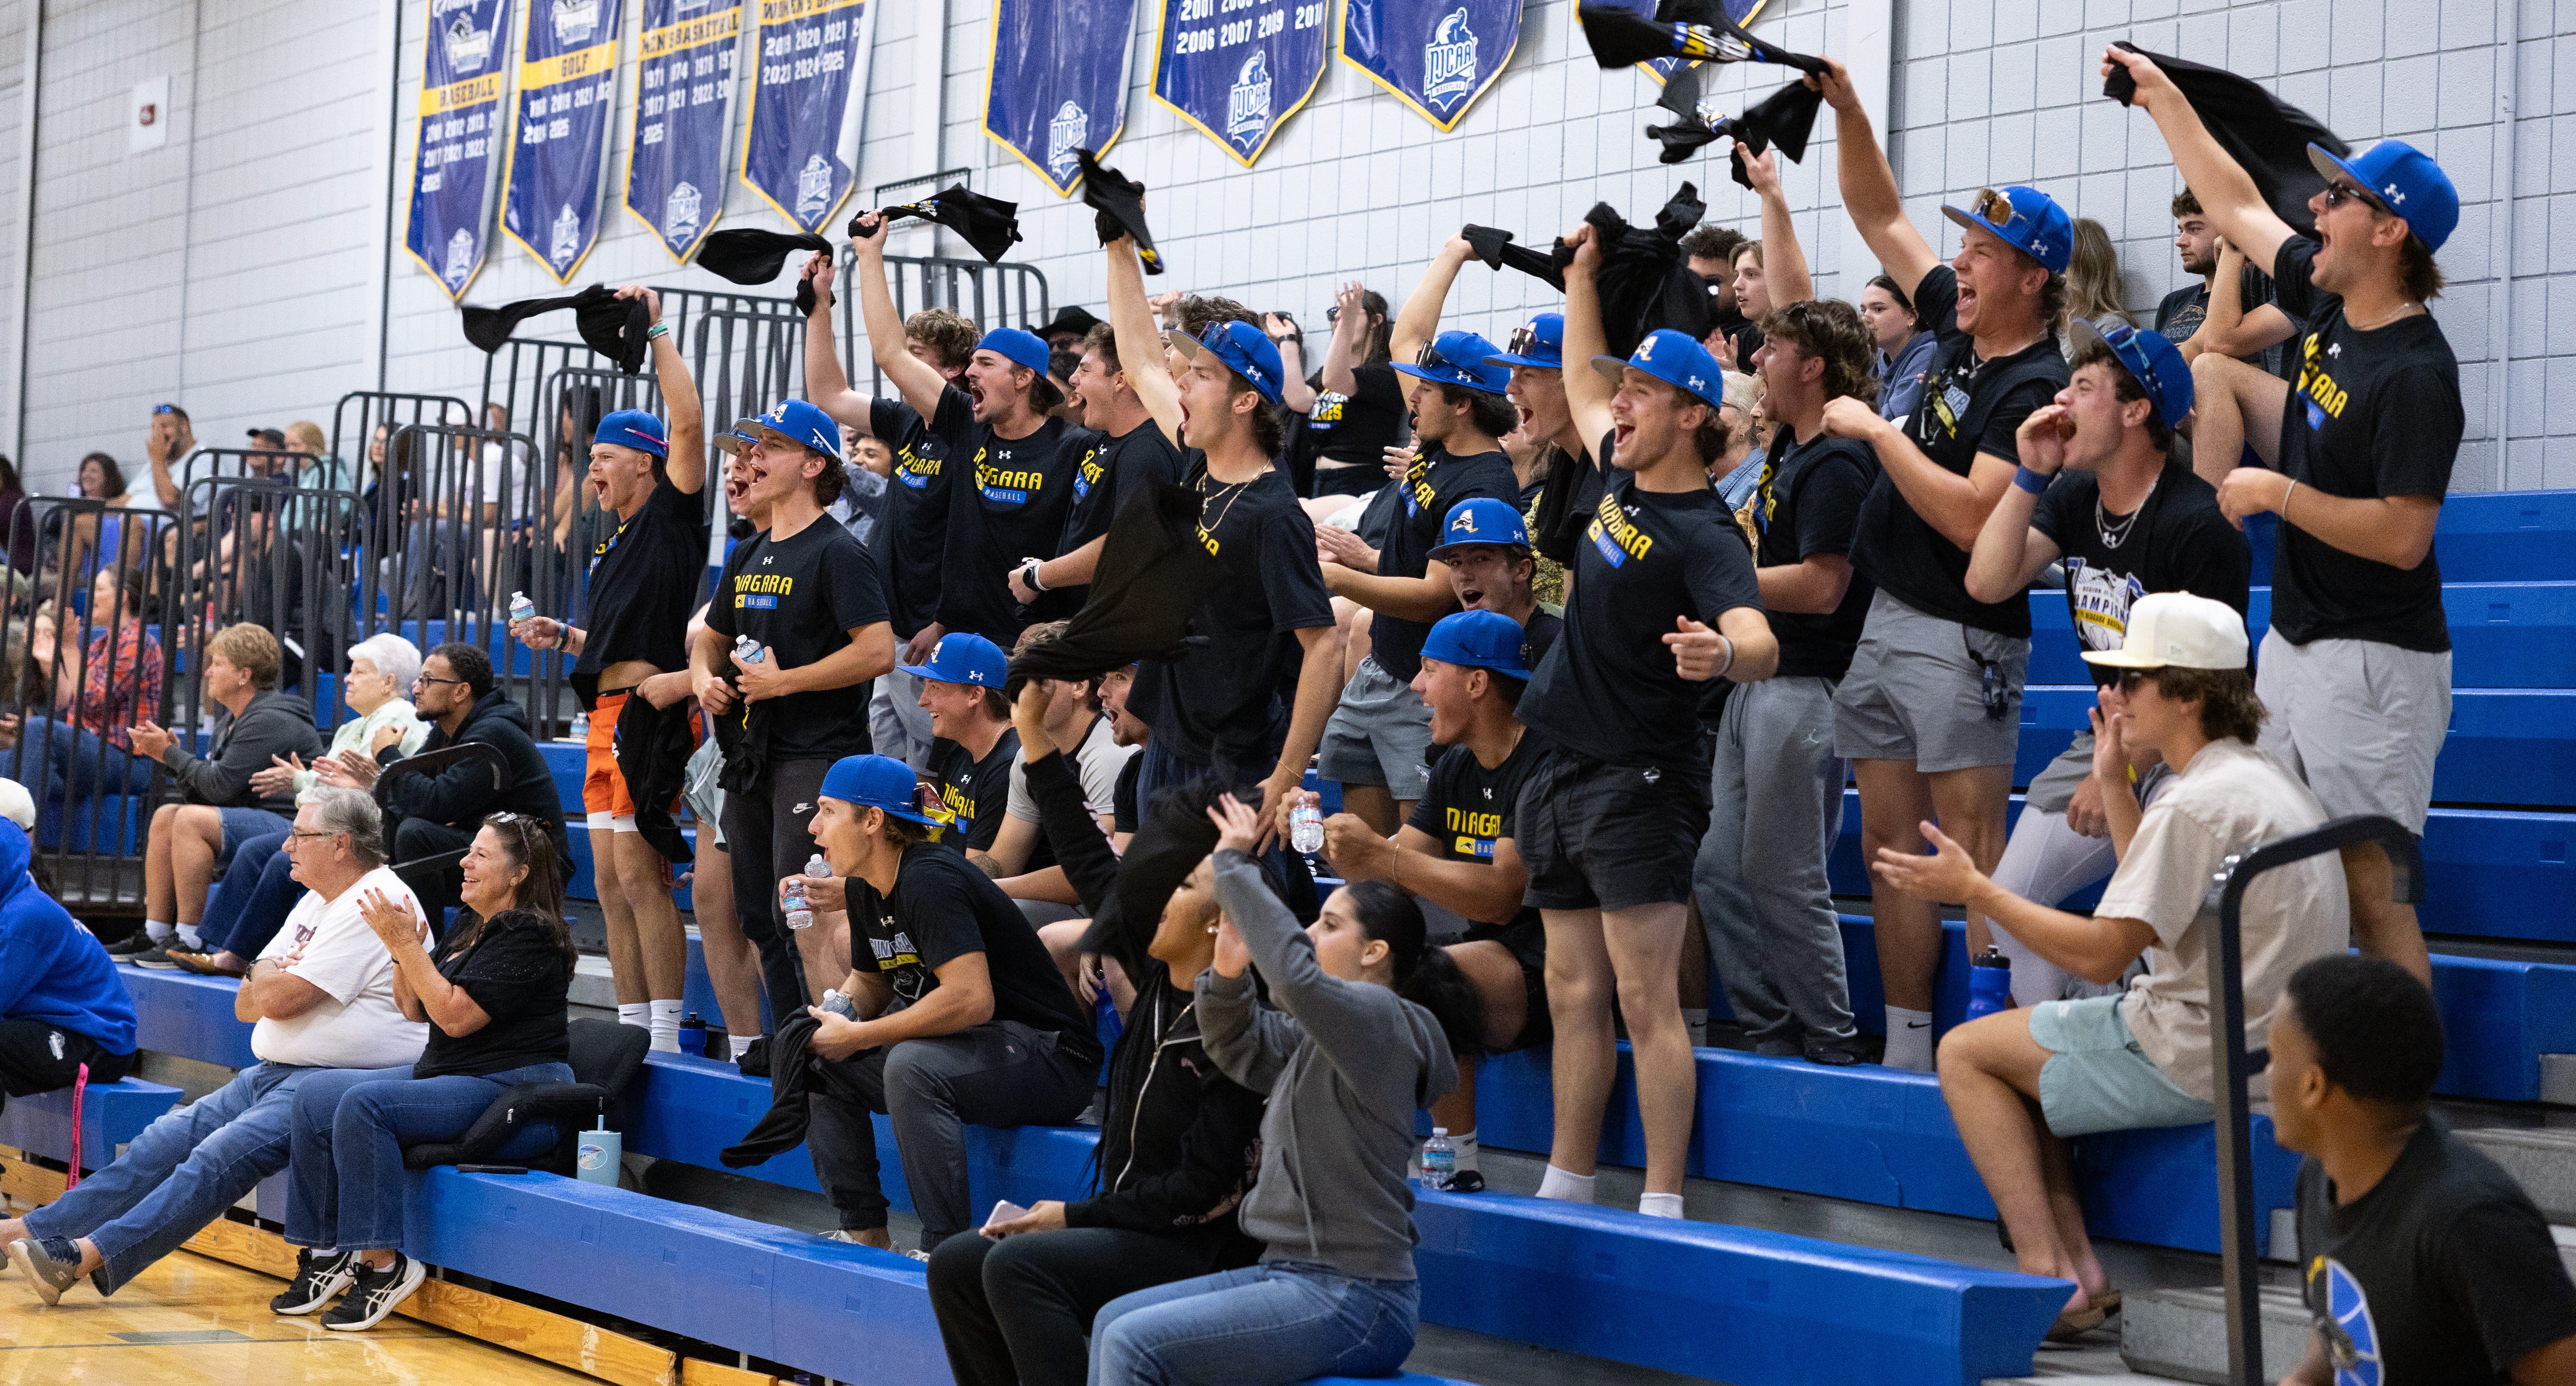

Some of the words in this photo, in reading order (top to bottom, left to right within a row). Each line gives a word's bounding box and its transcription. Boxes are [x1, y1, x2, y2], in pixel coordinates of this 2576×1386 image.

[1181, 0, 1213, 21] 2001
[796, 27, 820, 51] 2020
[824, 21, 846, 44] 2021
[1176, 28, 1215, 54] 2006
[1220, 19, 1252, 47] 2007
[561, 53, 589, 76] GOLF
[1429, 44, 1471, 85] NJCAA
[439, 79, 494, 107] BASEBALL
[692, 82, 714, 106] 2022
[1436, 83, 1462, 93] WRESTLING
[1232, 85, 1267, 123] NJCAA
[1052, 121, 1082, 155] NJCAA
[985, 489, 1021, 501] BASEBALL
[1598, 493, 1653, 561] NIAGARA
[735, 574, 793, 595] NIAGARA
[1447, 807, 1501, 837] NIAGA
[582, 1152, 598, 1162] OBX
